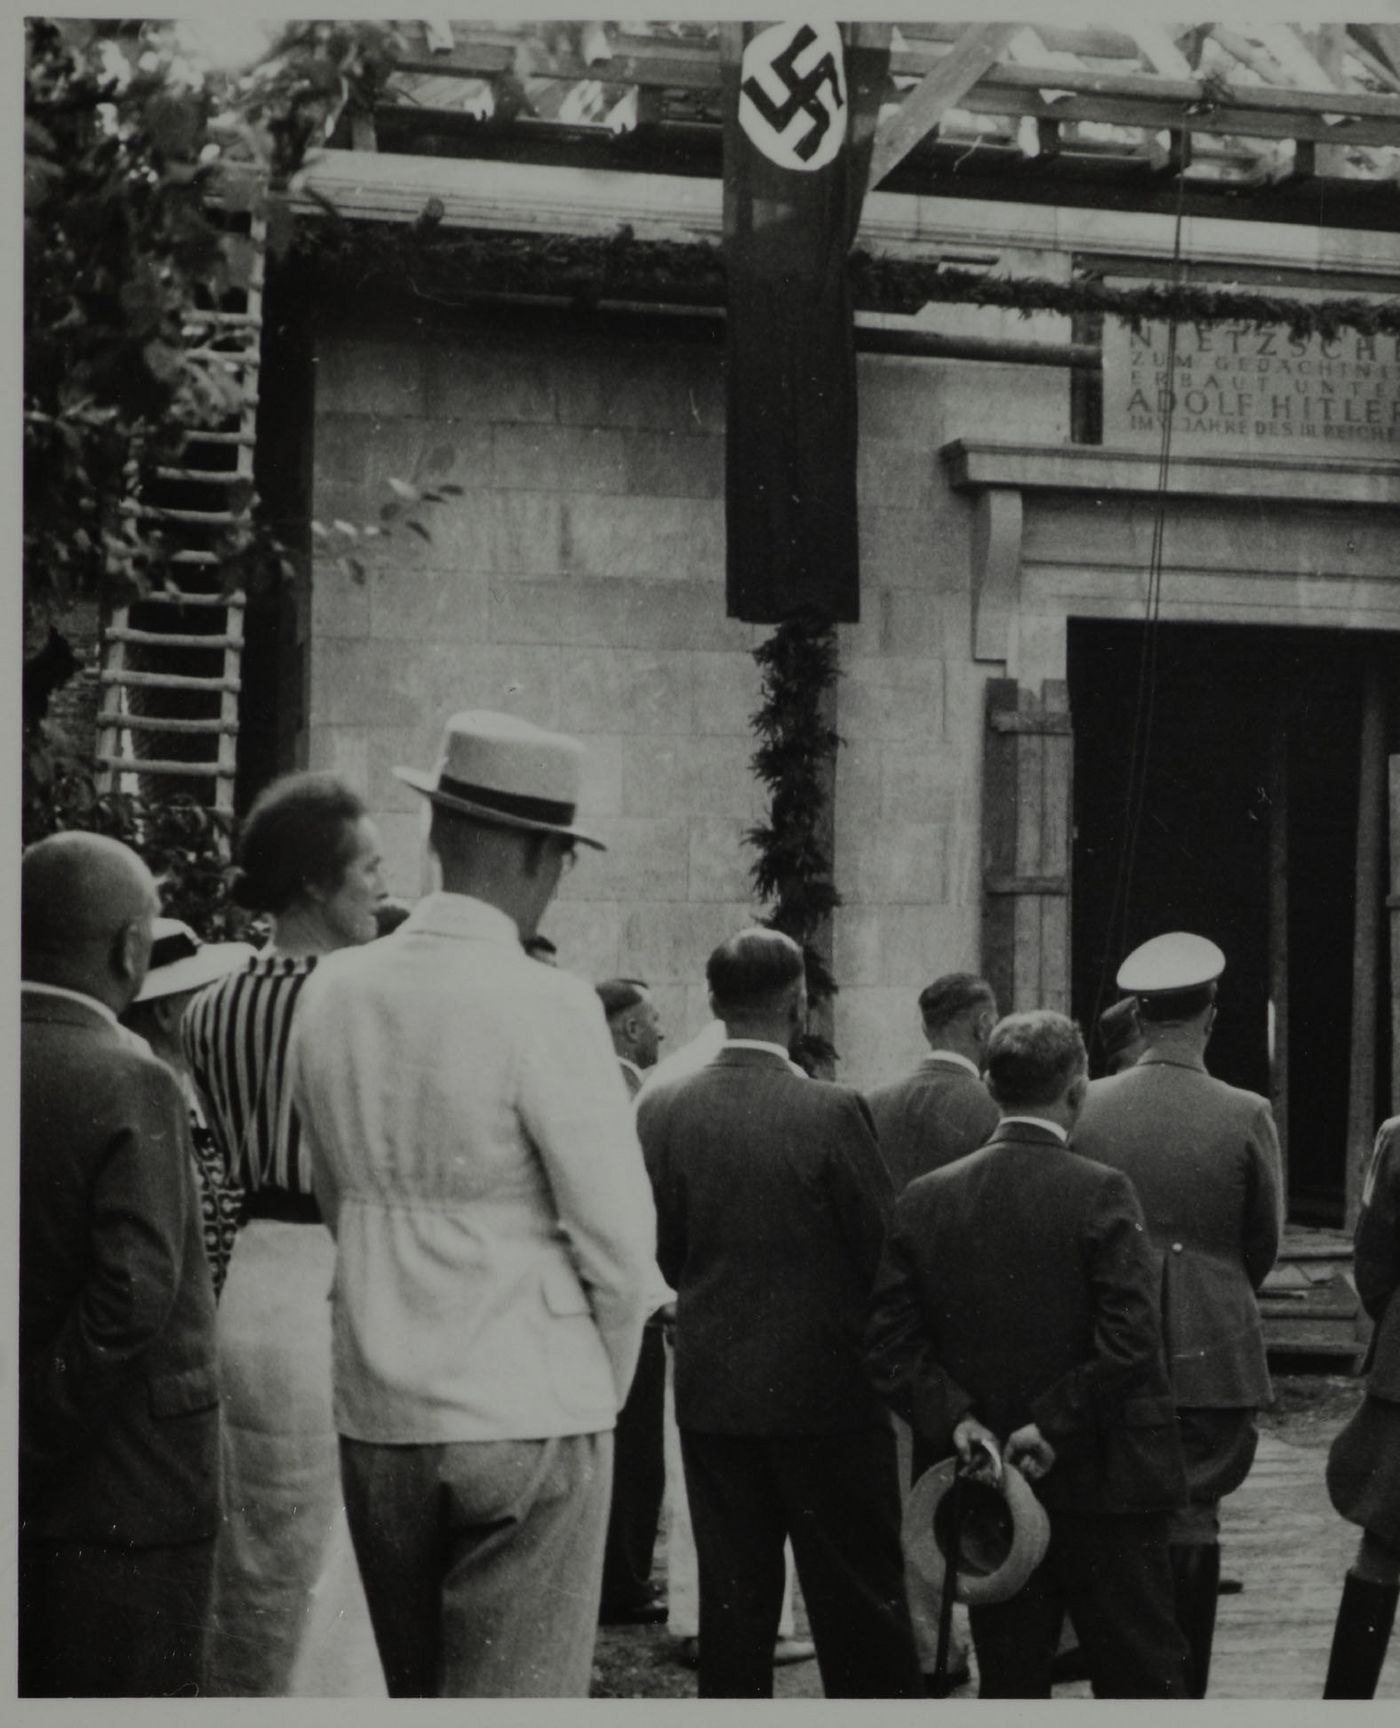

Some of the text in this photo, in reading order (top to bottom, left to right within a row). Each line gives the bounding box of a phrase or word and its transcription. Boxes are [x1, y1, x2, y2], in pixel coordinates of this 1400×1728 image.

[1132, 352, 1192, 368] ZUM
[1131, 370, 1269, 392] ERBAUT
[1127, 389, 1252, 416] ADOLF
[1131, 415, 1153, 431] IM
[1182, 418, 1247, 435] JAHRE
[1255, 420, 1293, 437] DES
